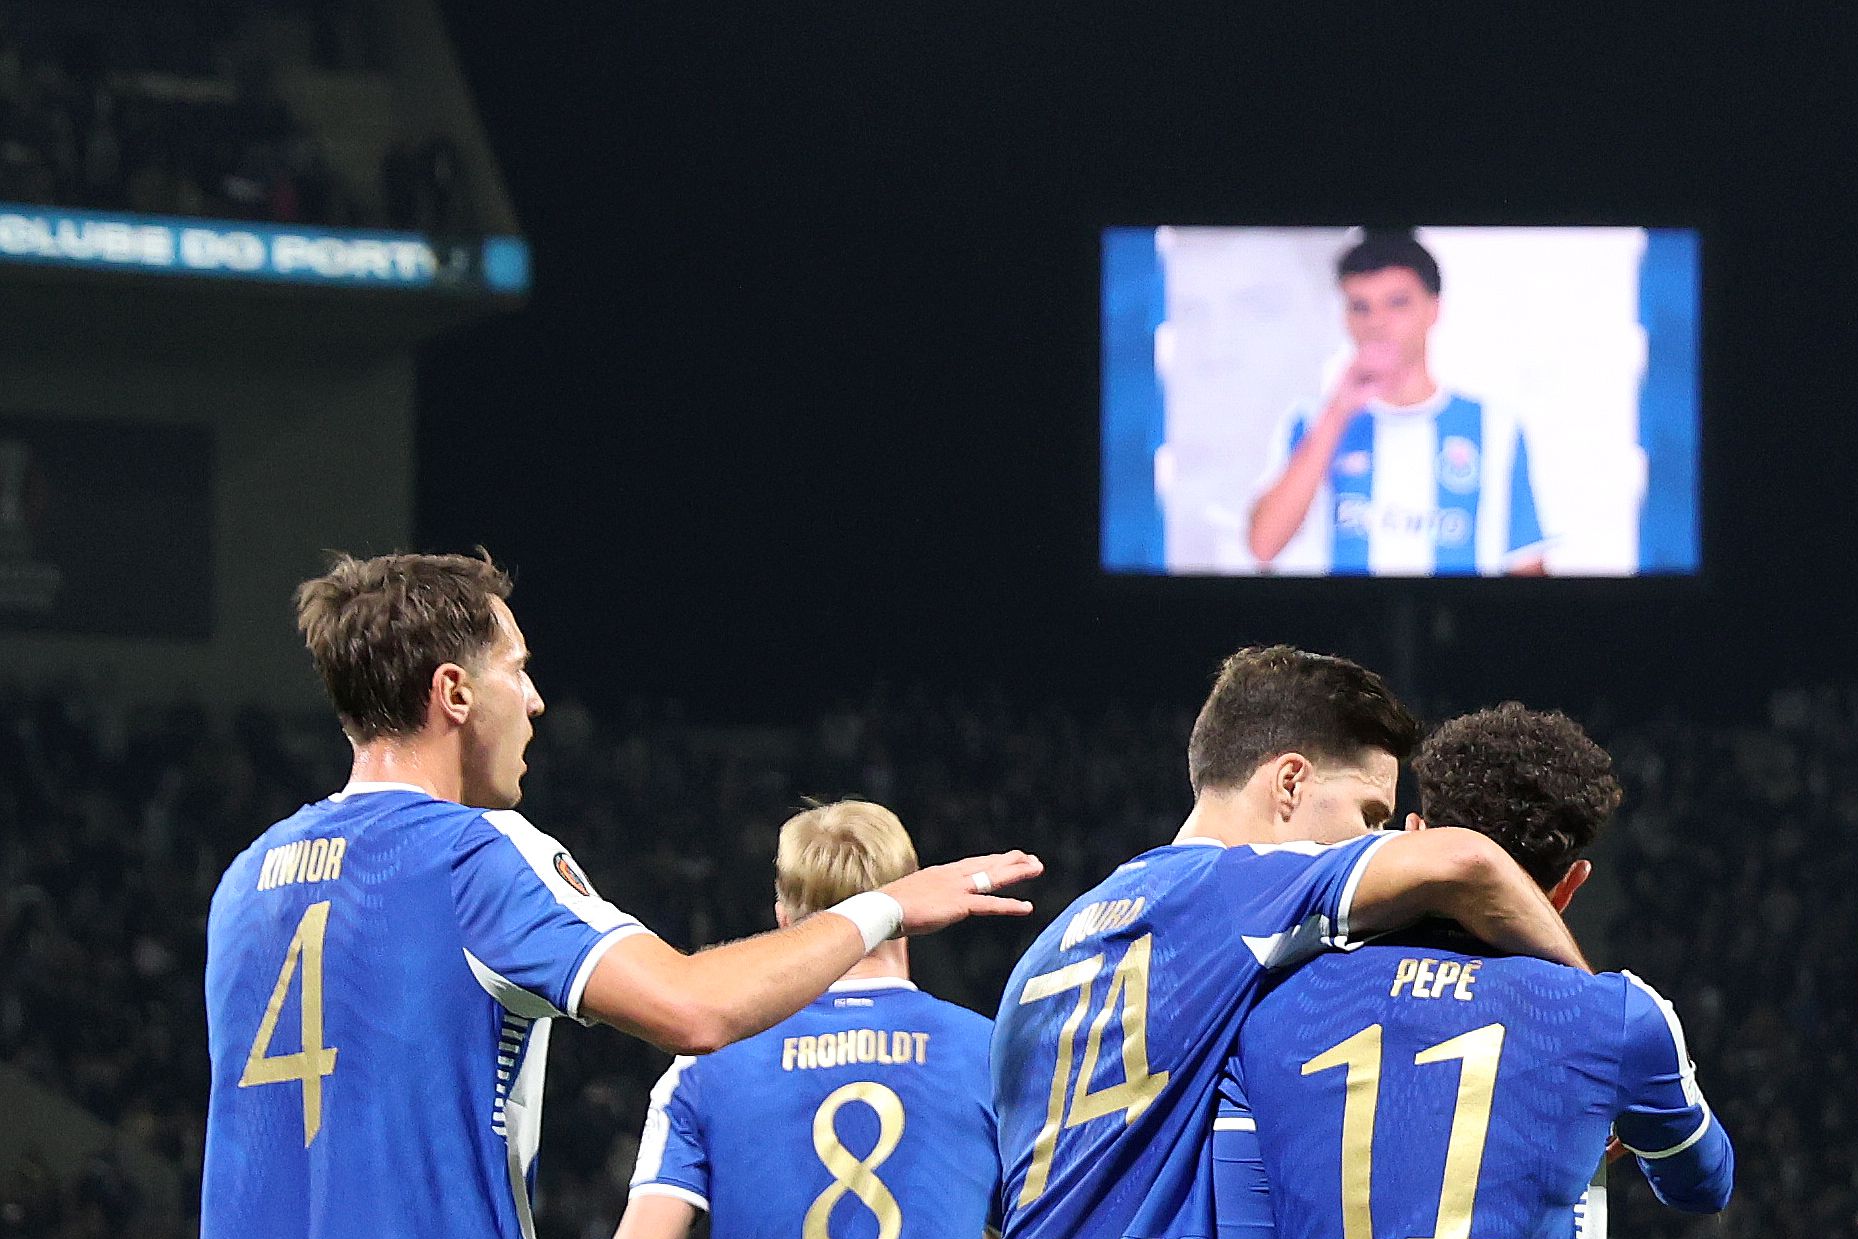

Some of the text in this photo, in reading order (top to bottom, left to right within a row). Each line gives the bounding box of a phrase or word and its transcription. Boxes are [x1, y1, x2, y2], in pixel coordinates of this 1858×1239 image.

[256, 835, 347, 891] KIWIOR
[237, 900, 339, 1149] 4
[782, 1029, 931, 1072] FROHOLDT
[1018, 932, 1170, 1209] 74
